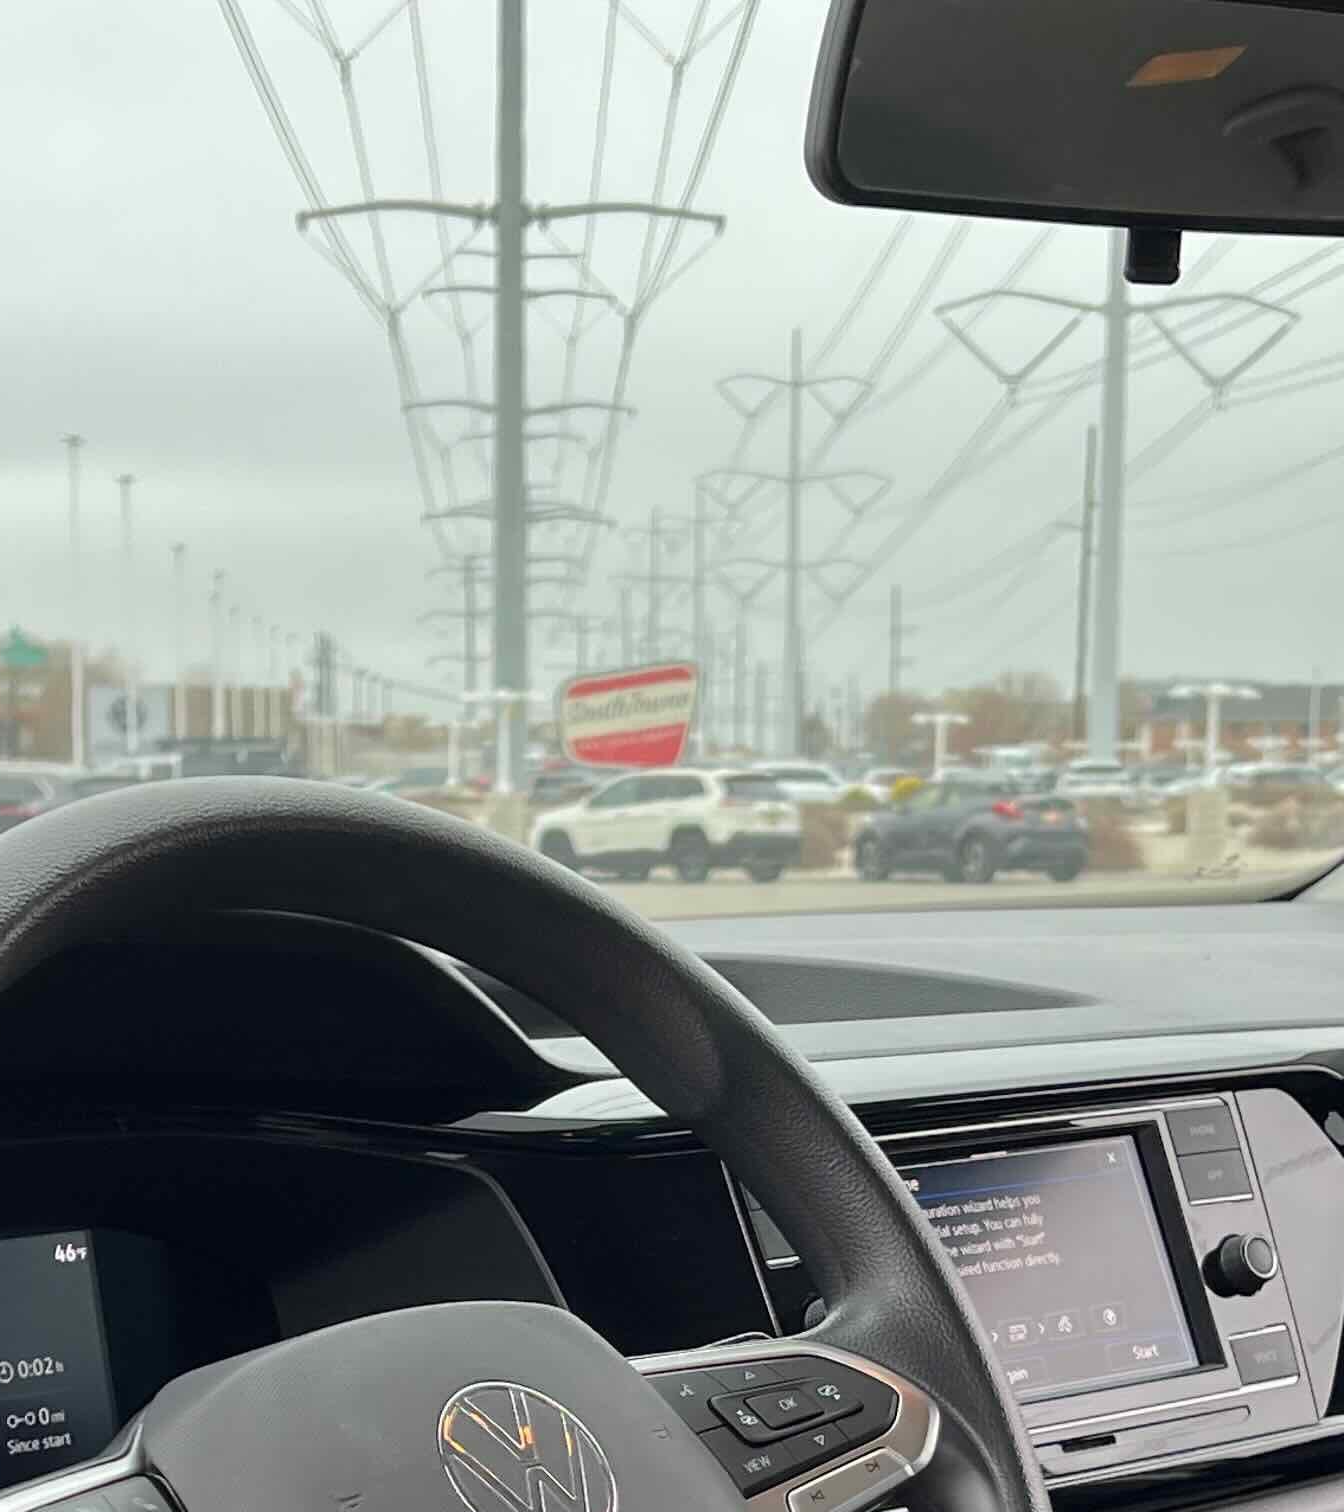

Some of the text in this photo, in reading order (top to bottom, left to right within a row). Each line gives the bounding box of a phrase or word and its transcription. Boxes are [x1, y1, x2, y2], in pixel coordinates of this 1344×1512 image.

[926, 1204, 960, 1219] uration
[1022, 1194, 1041, 1208] you
[983, 1220, 1003, 1231] You
[1005, 1218, 1022, 1229] can
[1132, 1344, 1160, 1361] Start
[7, 1432, 72, 1455] Since start
